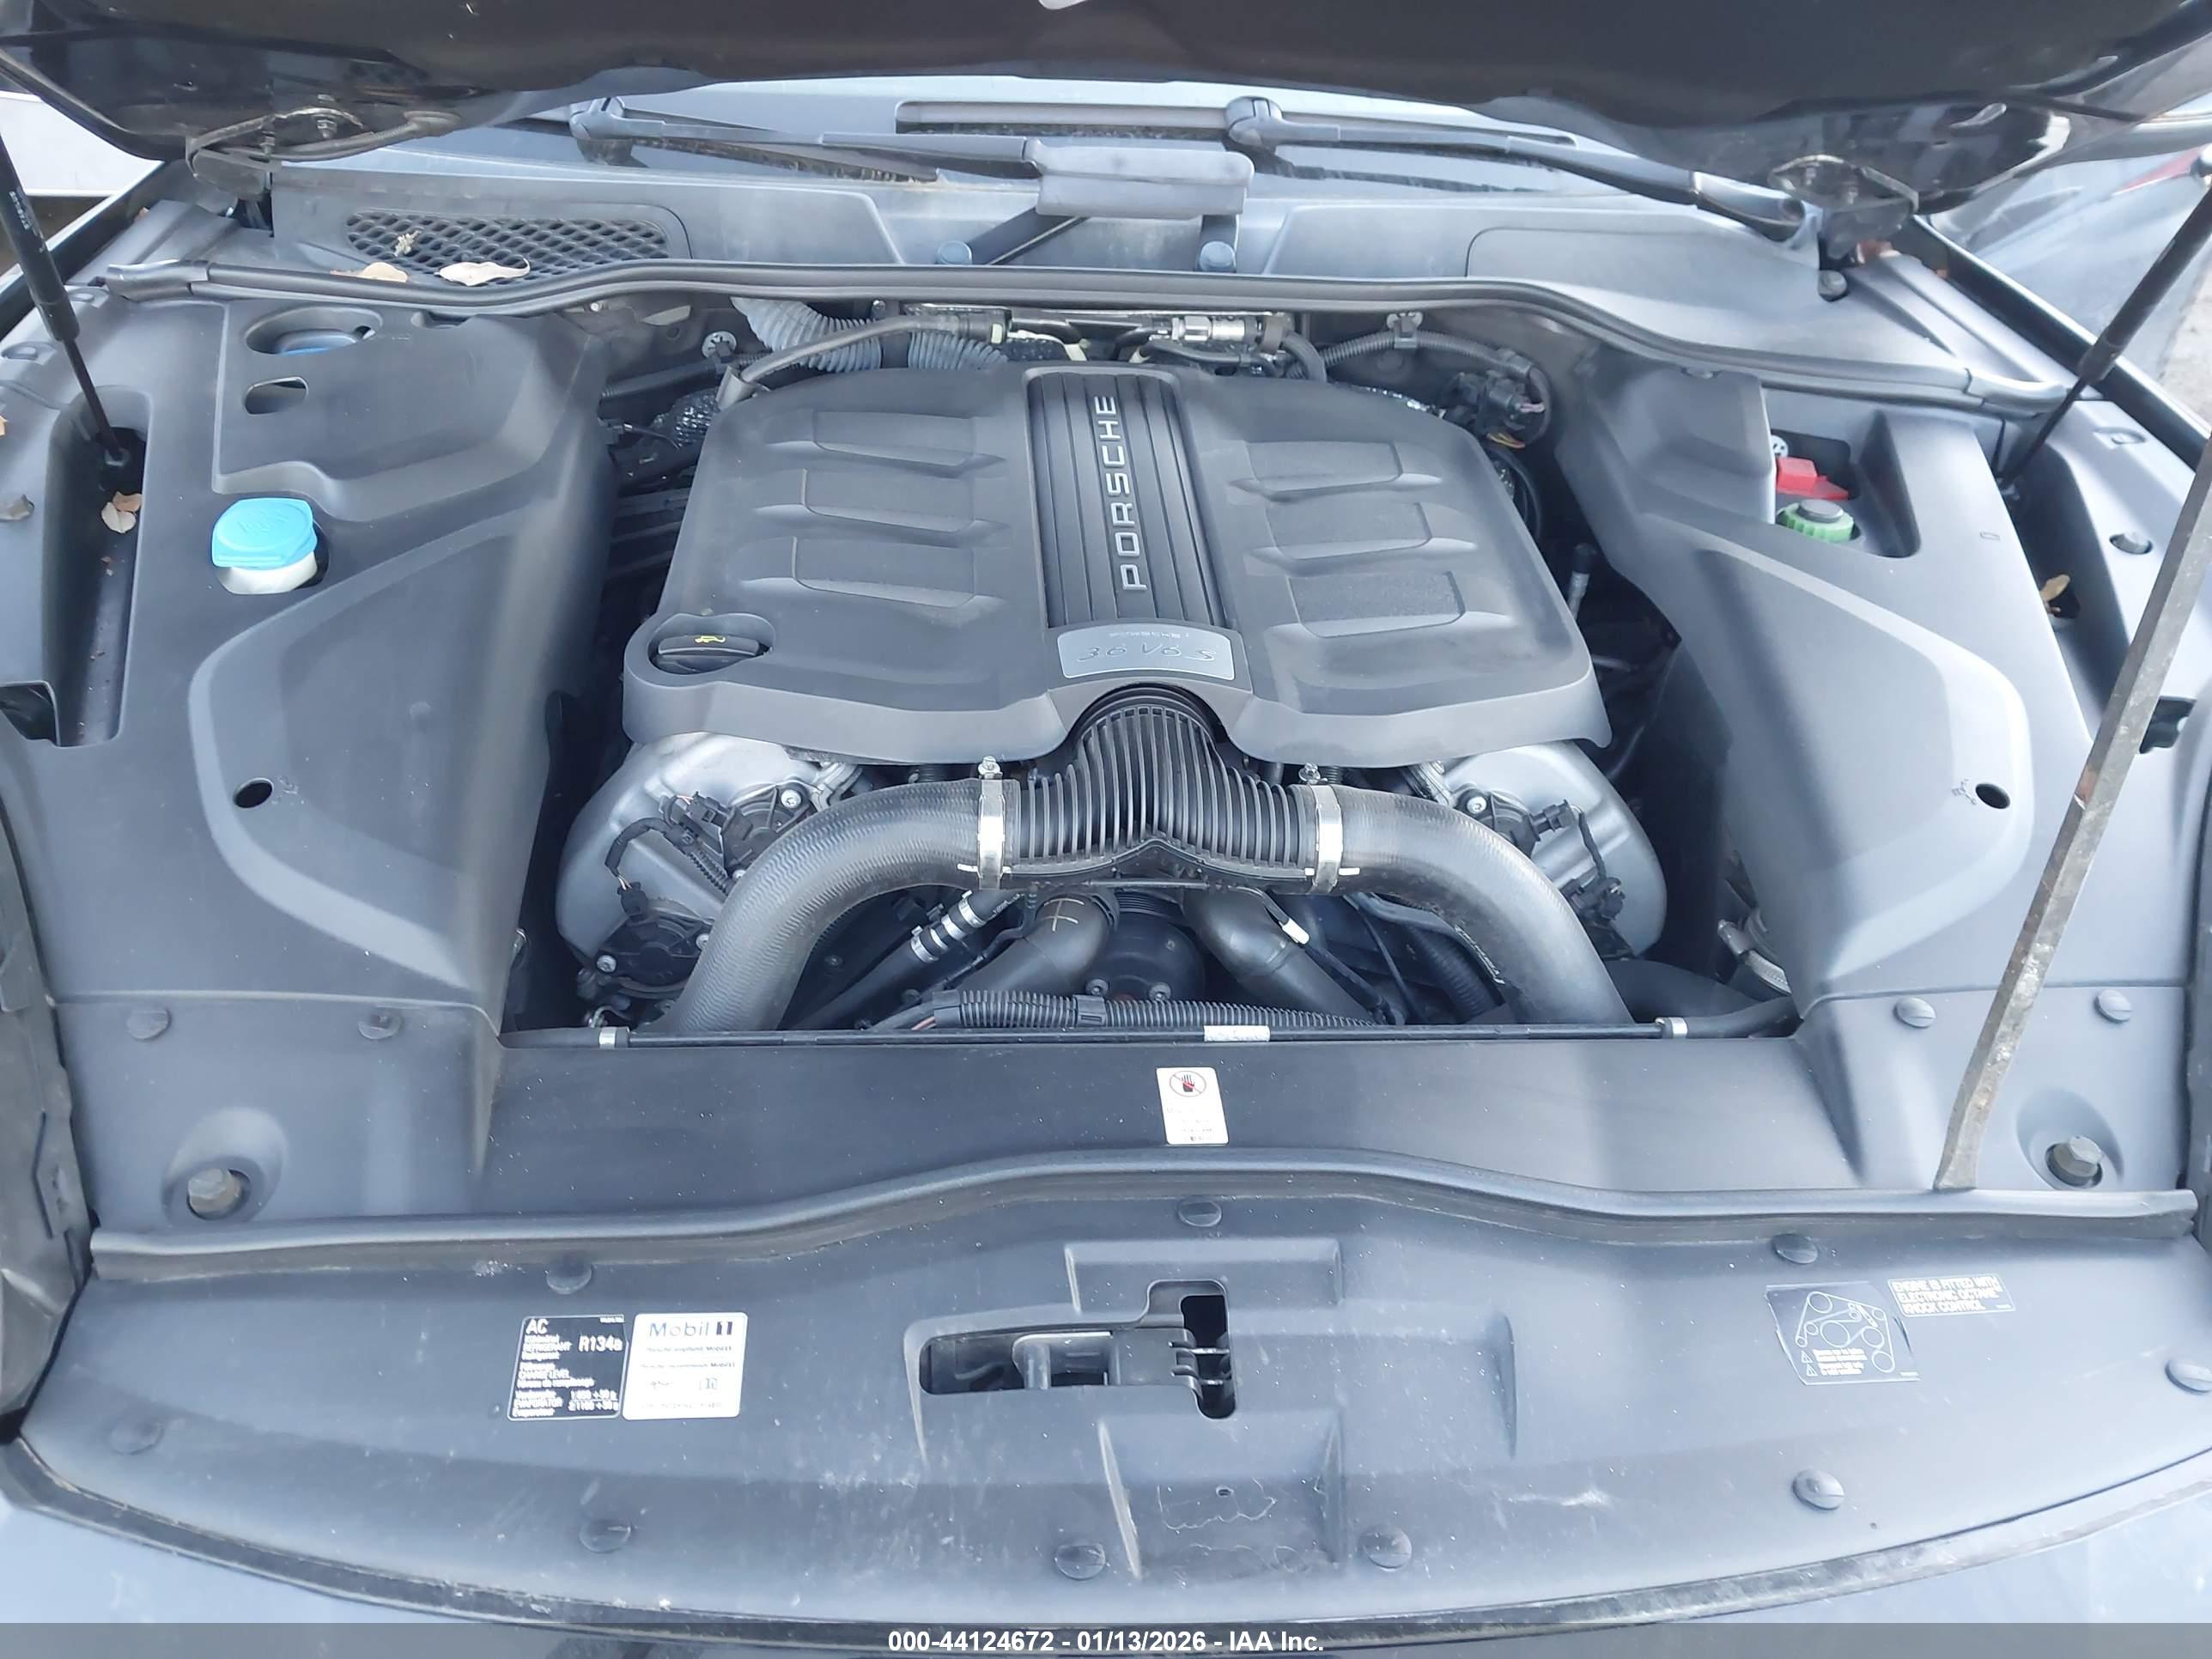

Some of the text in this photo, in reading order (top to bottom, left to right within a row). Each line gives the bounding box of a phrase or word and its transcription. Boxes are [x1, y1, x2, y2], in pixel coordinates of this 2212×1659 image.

[1094, 396, 1148, 592] PORSCHE
[526, 1319, 550, 1334] AC
[649, 1322, 709, 1337] Mobil
[578, 1334, 623, 1352] R134a
